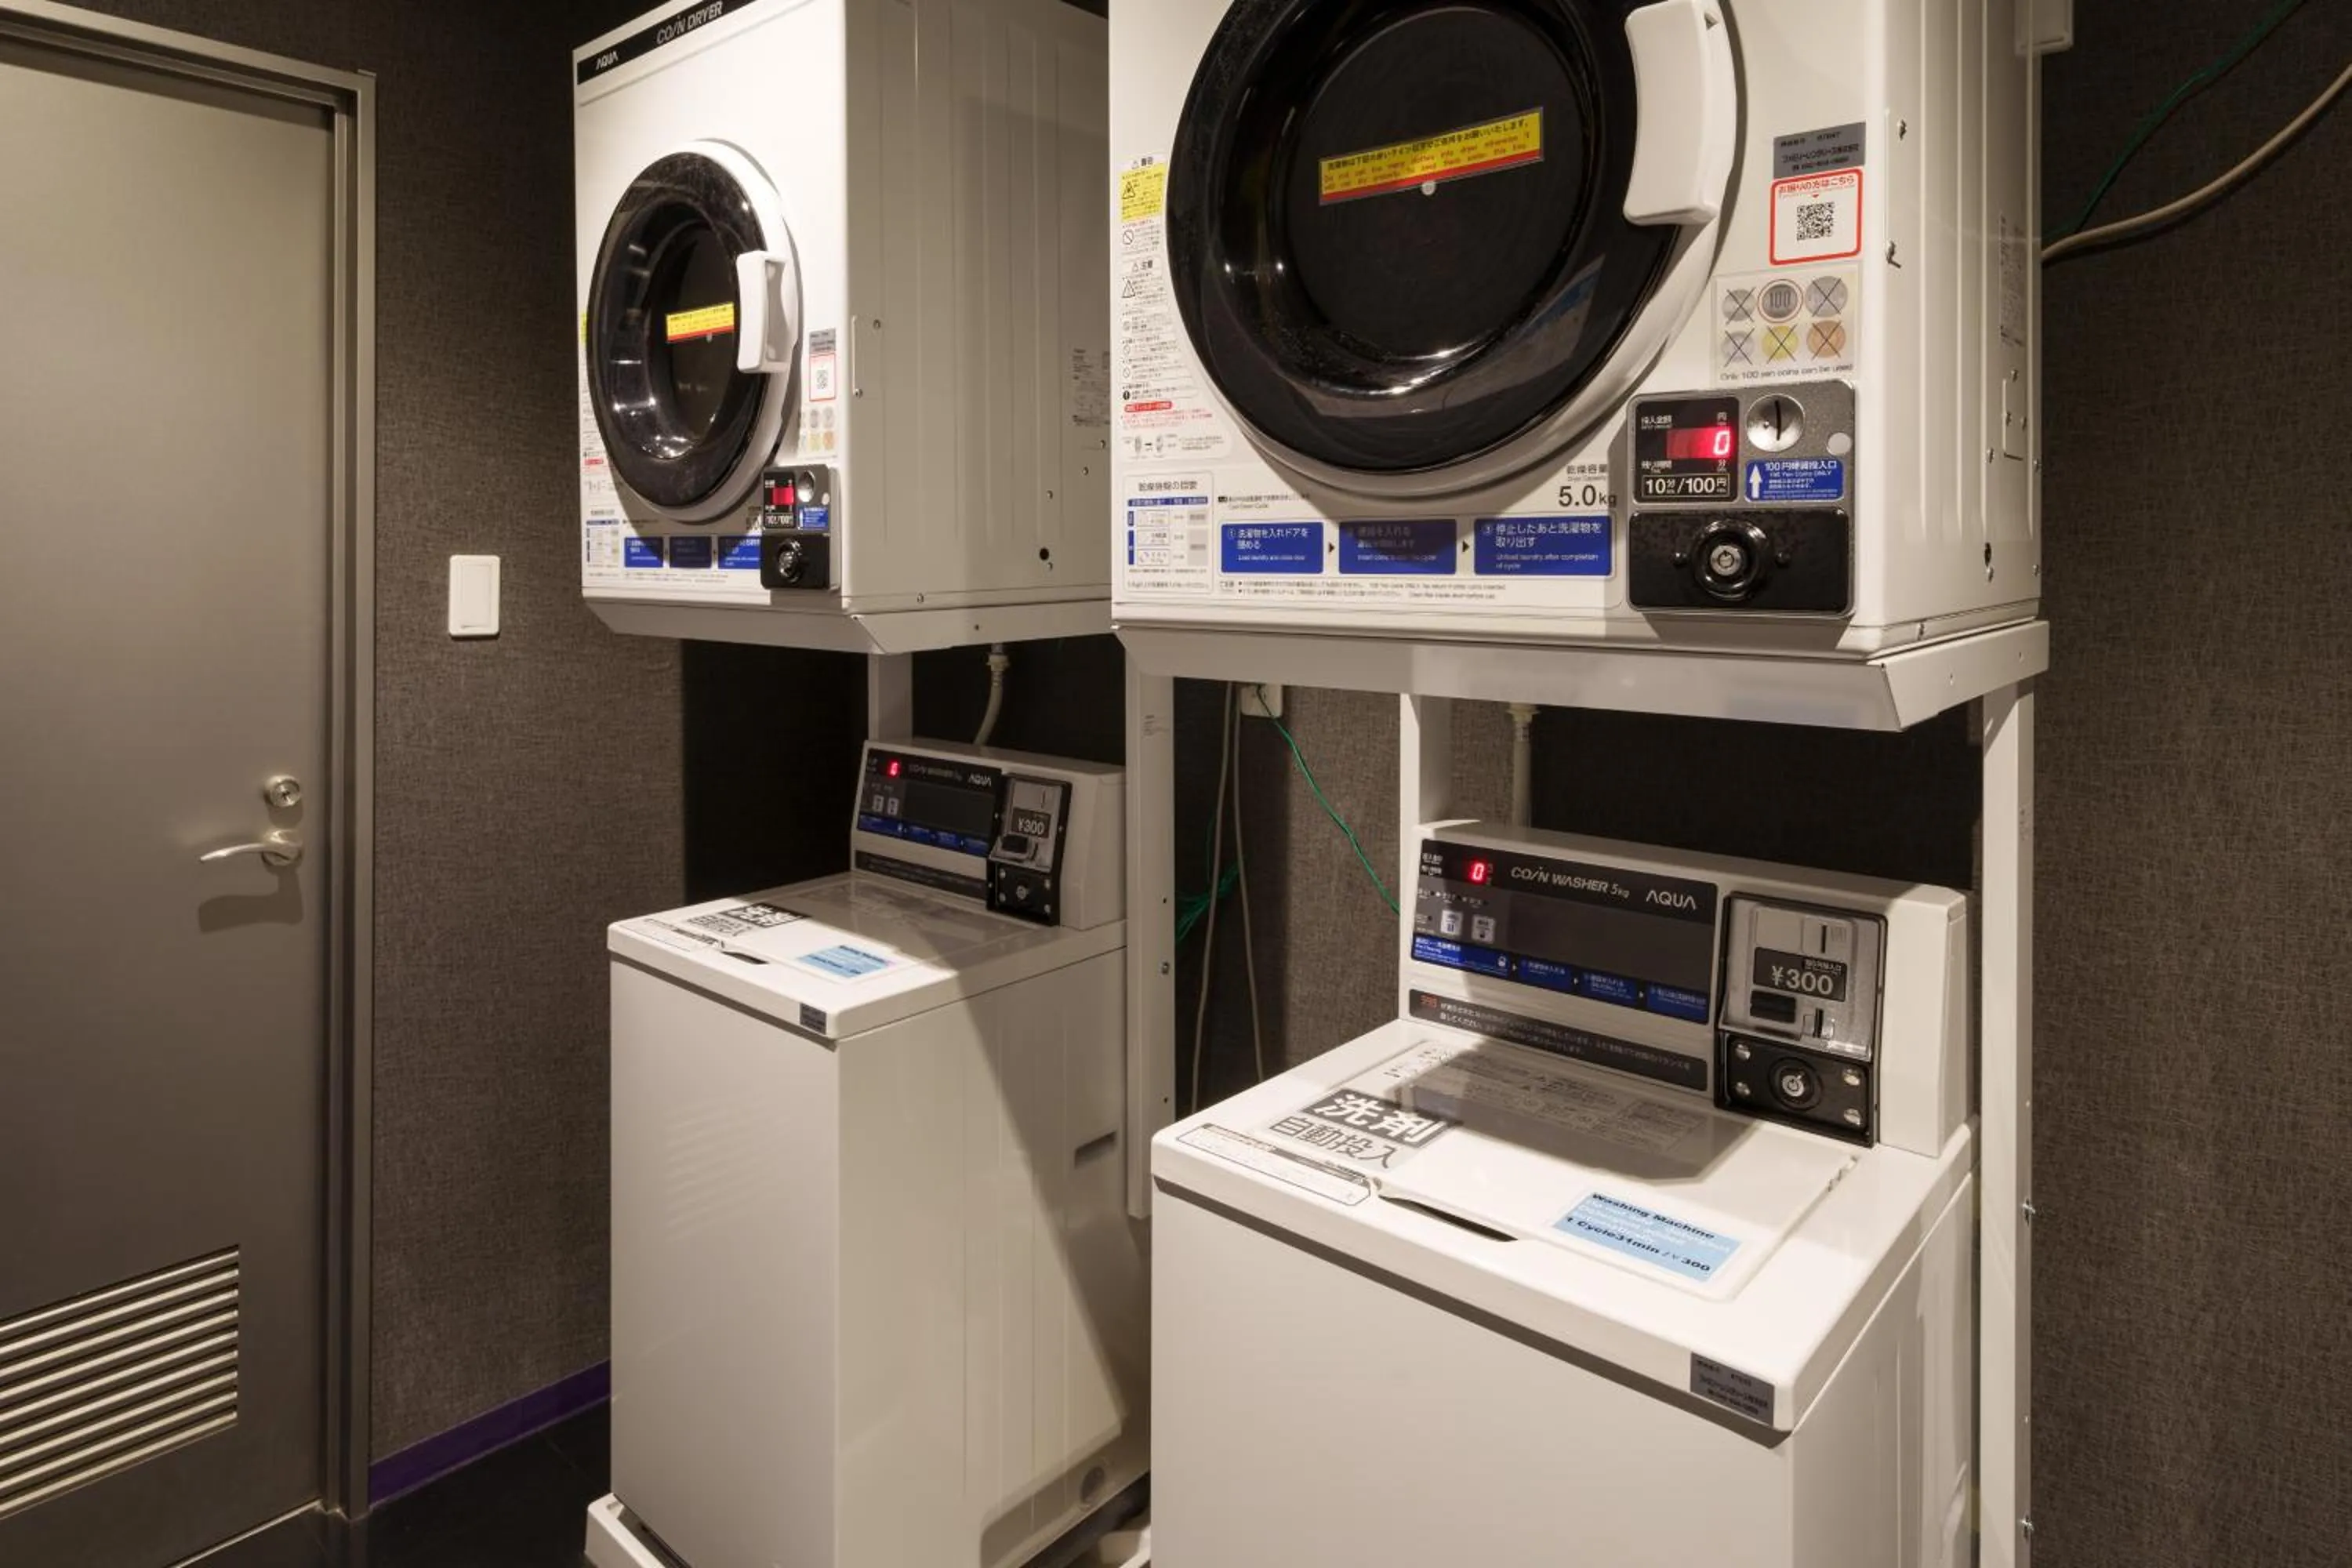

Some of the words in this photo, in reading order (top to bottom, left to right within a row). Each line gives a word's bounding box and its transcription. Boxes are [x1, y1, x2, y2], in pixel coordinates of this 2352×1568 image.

[688, 1, 723, 30] DRYER
[1713, 430, 1731, 456] 0
[1018, 817, 1044, 835] ¥300
[1472, 862, 1484, 881] 0
[1552, 873, 1608, 892] WASHER
[1646, 889, 1697, 910] AQUA
[1771, 965, 1834, 996] ¥300
[1313, 1093, 1448, 1145] 洗剤
[1269, 1116, 1399, 1169] 自動投入
[1592, 1192, 1650, 1218] Washing
[1653, 1214, 1715, 1240] Machine
